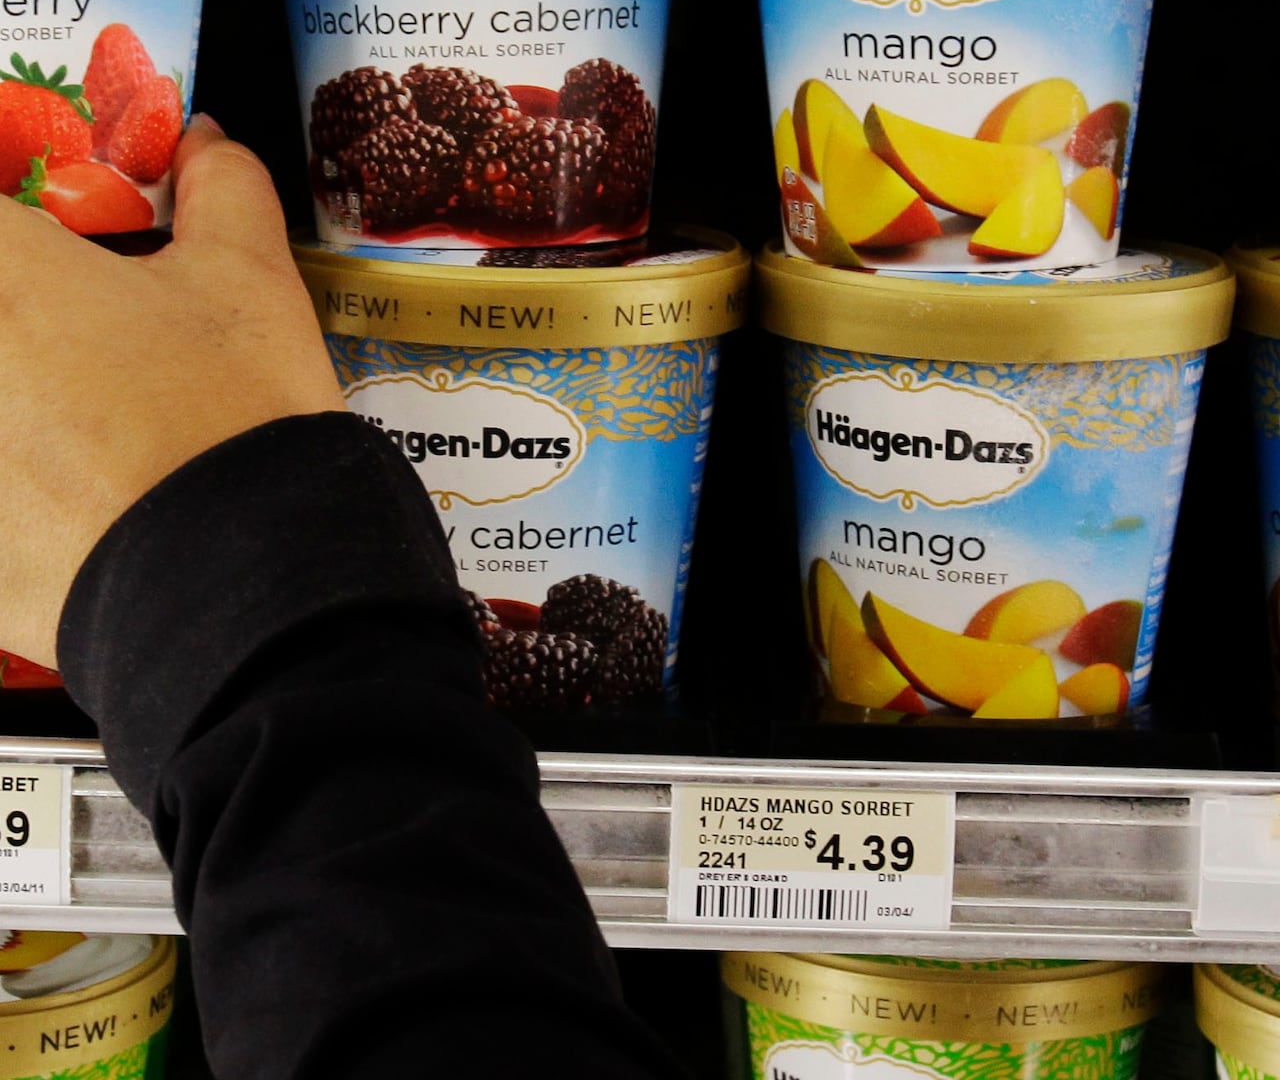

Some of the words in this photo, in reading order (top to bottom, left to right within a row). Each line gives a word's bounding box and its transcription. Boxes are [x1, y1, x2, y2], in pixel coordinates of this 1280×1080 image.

[0, 26, 74, 41] SORBET
[303, 3, 475, 41] blackberry
[490, 0, 640, 34] cabernet
[369, 45, 399, 59] ALL
[405, 45, 489, 59] NATURAL
[496, 42, 566, 57] SORBET
[843, 30, 997, 69] mango
[824, 67, 853, 82] ALL
[858, 68, 940, 85] NATURAL
[947, 71, 1019, 86] SORBET
[459, 303, 554, 330] NEW!
[615, 300, 691, 327] NEW!
[470, 516, 638, 550] cabernet
[843, 519, 986, 565] mango
[701, 797, 760, 812] HDAZS
[767, 799, 833, 815] MANGO
[841, 800, 915, 817] SORBET
[698, 852, 746, 869] 2241
[804, 828, 914, 871] $4.39
[851, 993, 936, 1025] NEW!
[40, 1017, 117, 1054] NEW!
